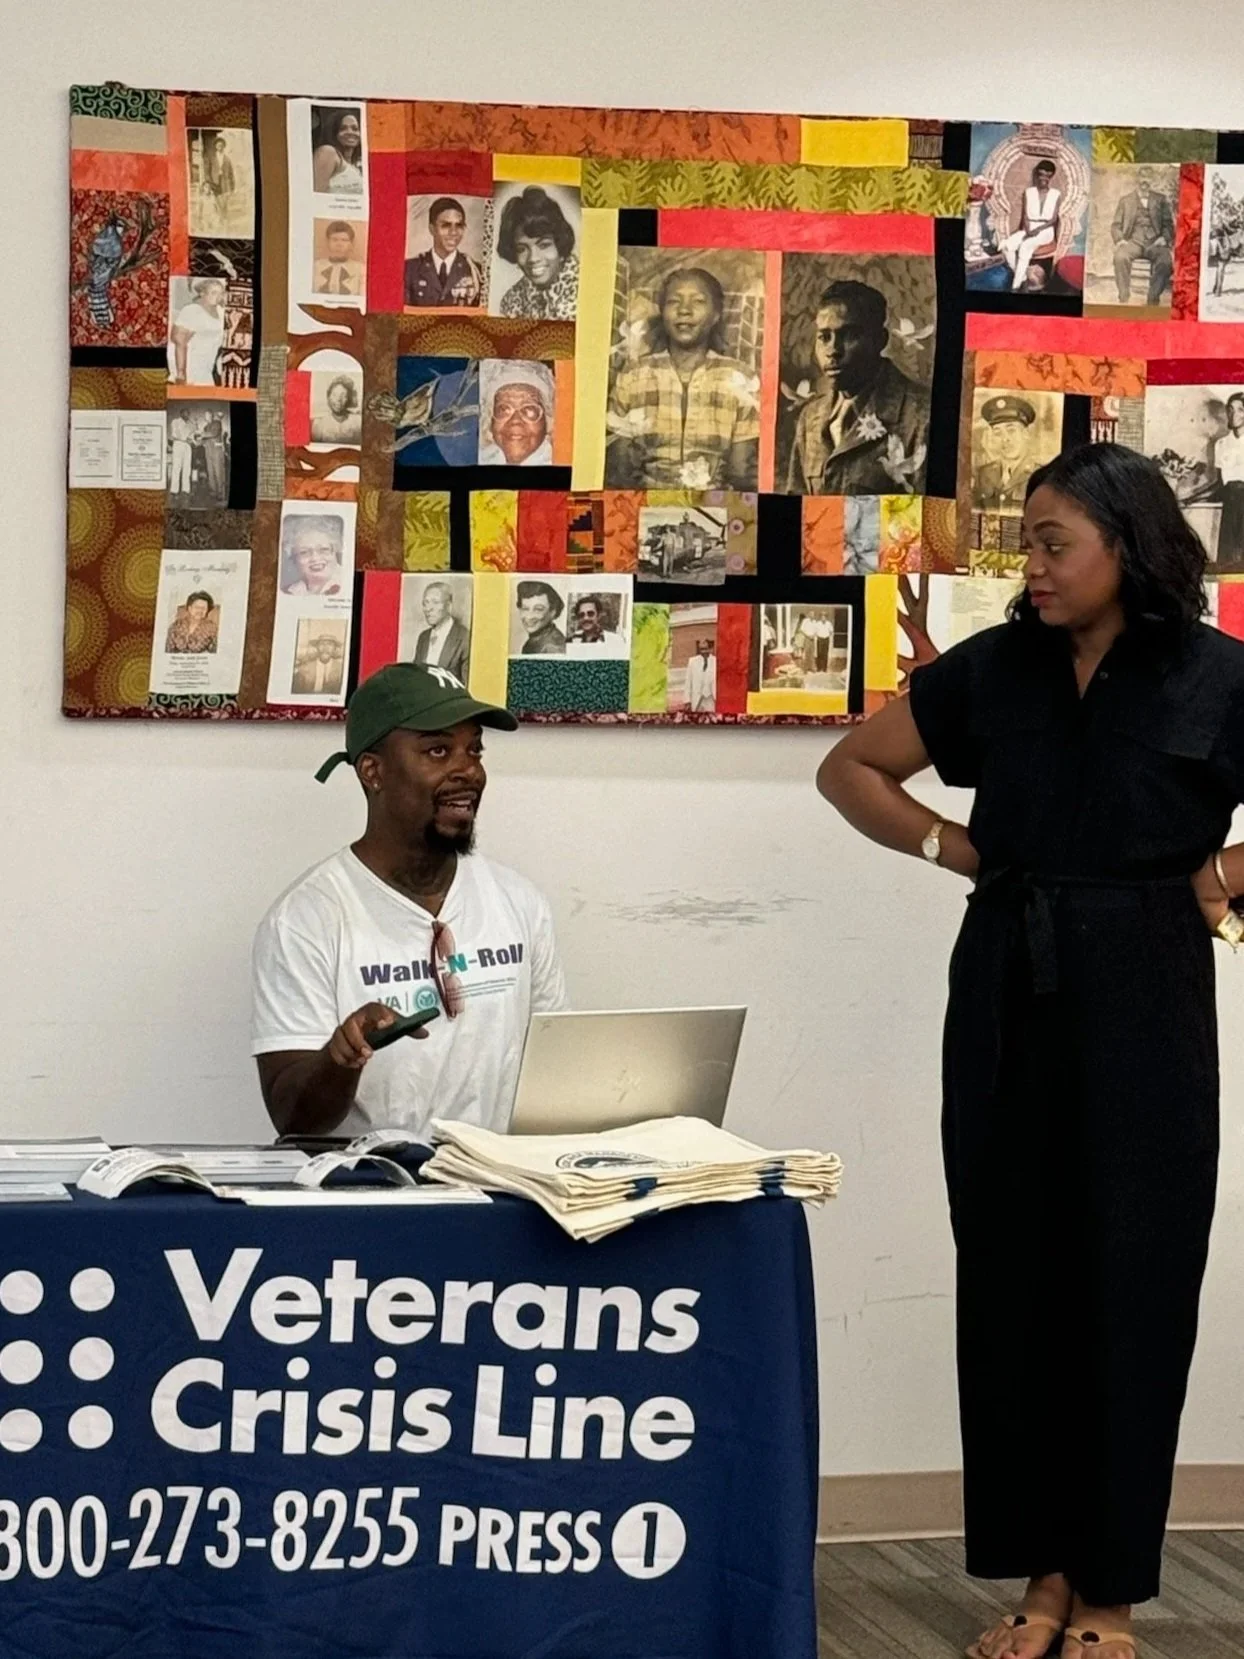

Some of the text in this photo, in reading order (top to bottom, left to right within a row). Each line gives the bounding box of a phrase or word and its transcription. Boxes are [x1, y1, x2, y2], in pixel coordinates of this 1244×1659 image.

[163, 1247, 701, 1354] Veterans
[150, 1356, 695, 1462] Crisis Line
[438, 1504, 602, 1574] PRESS
